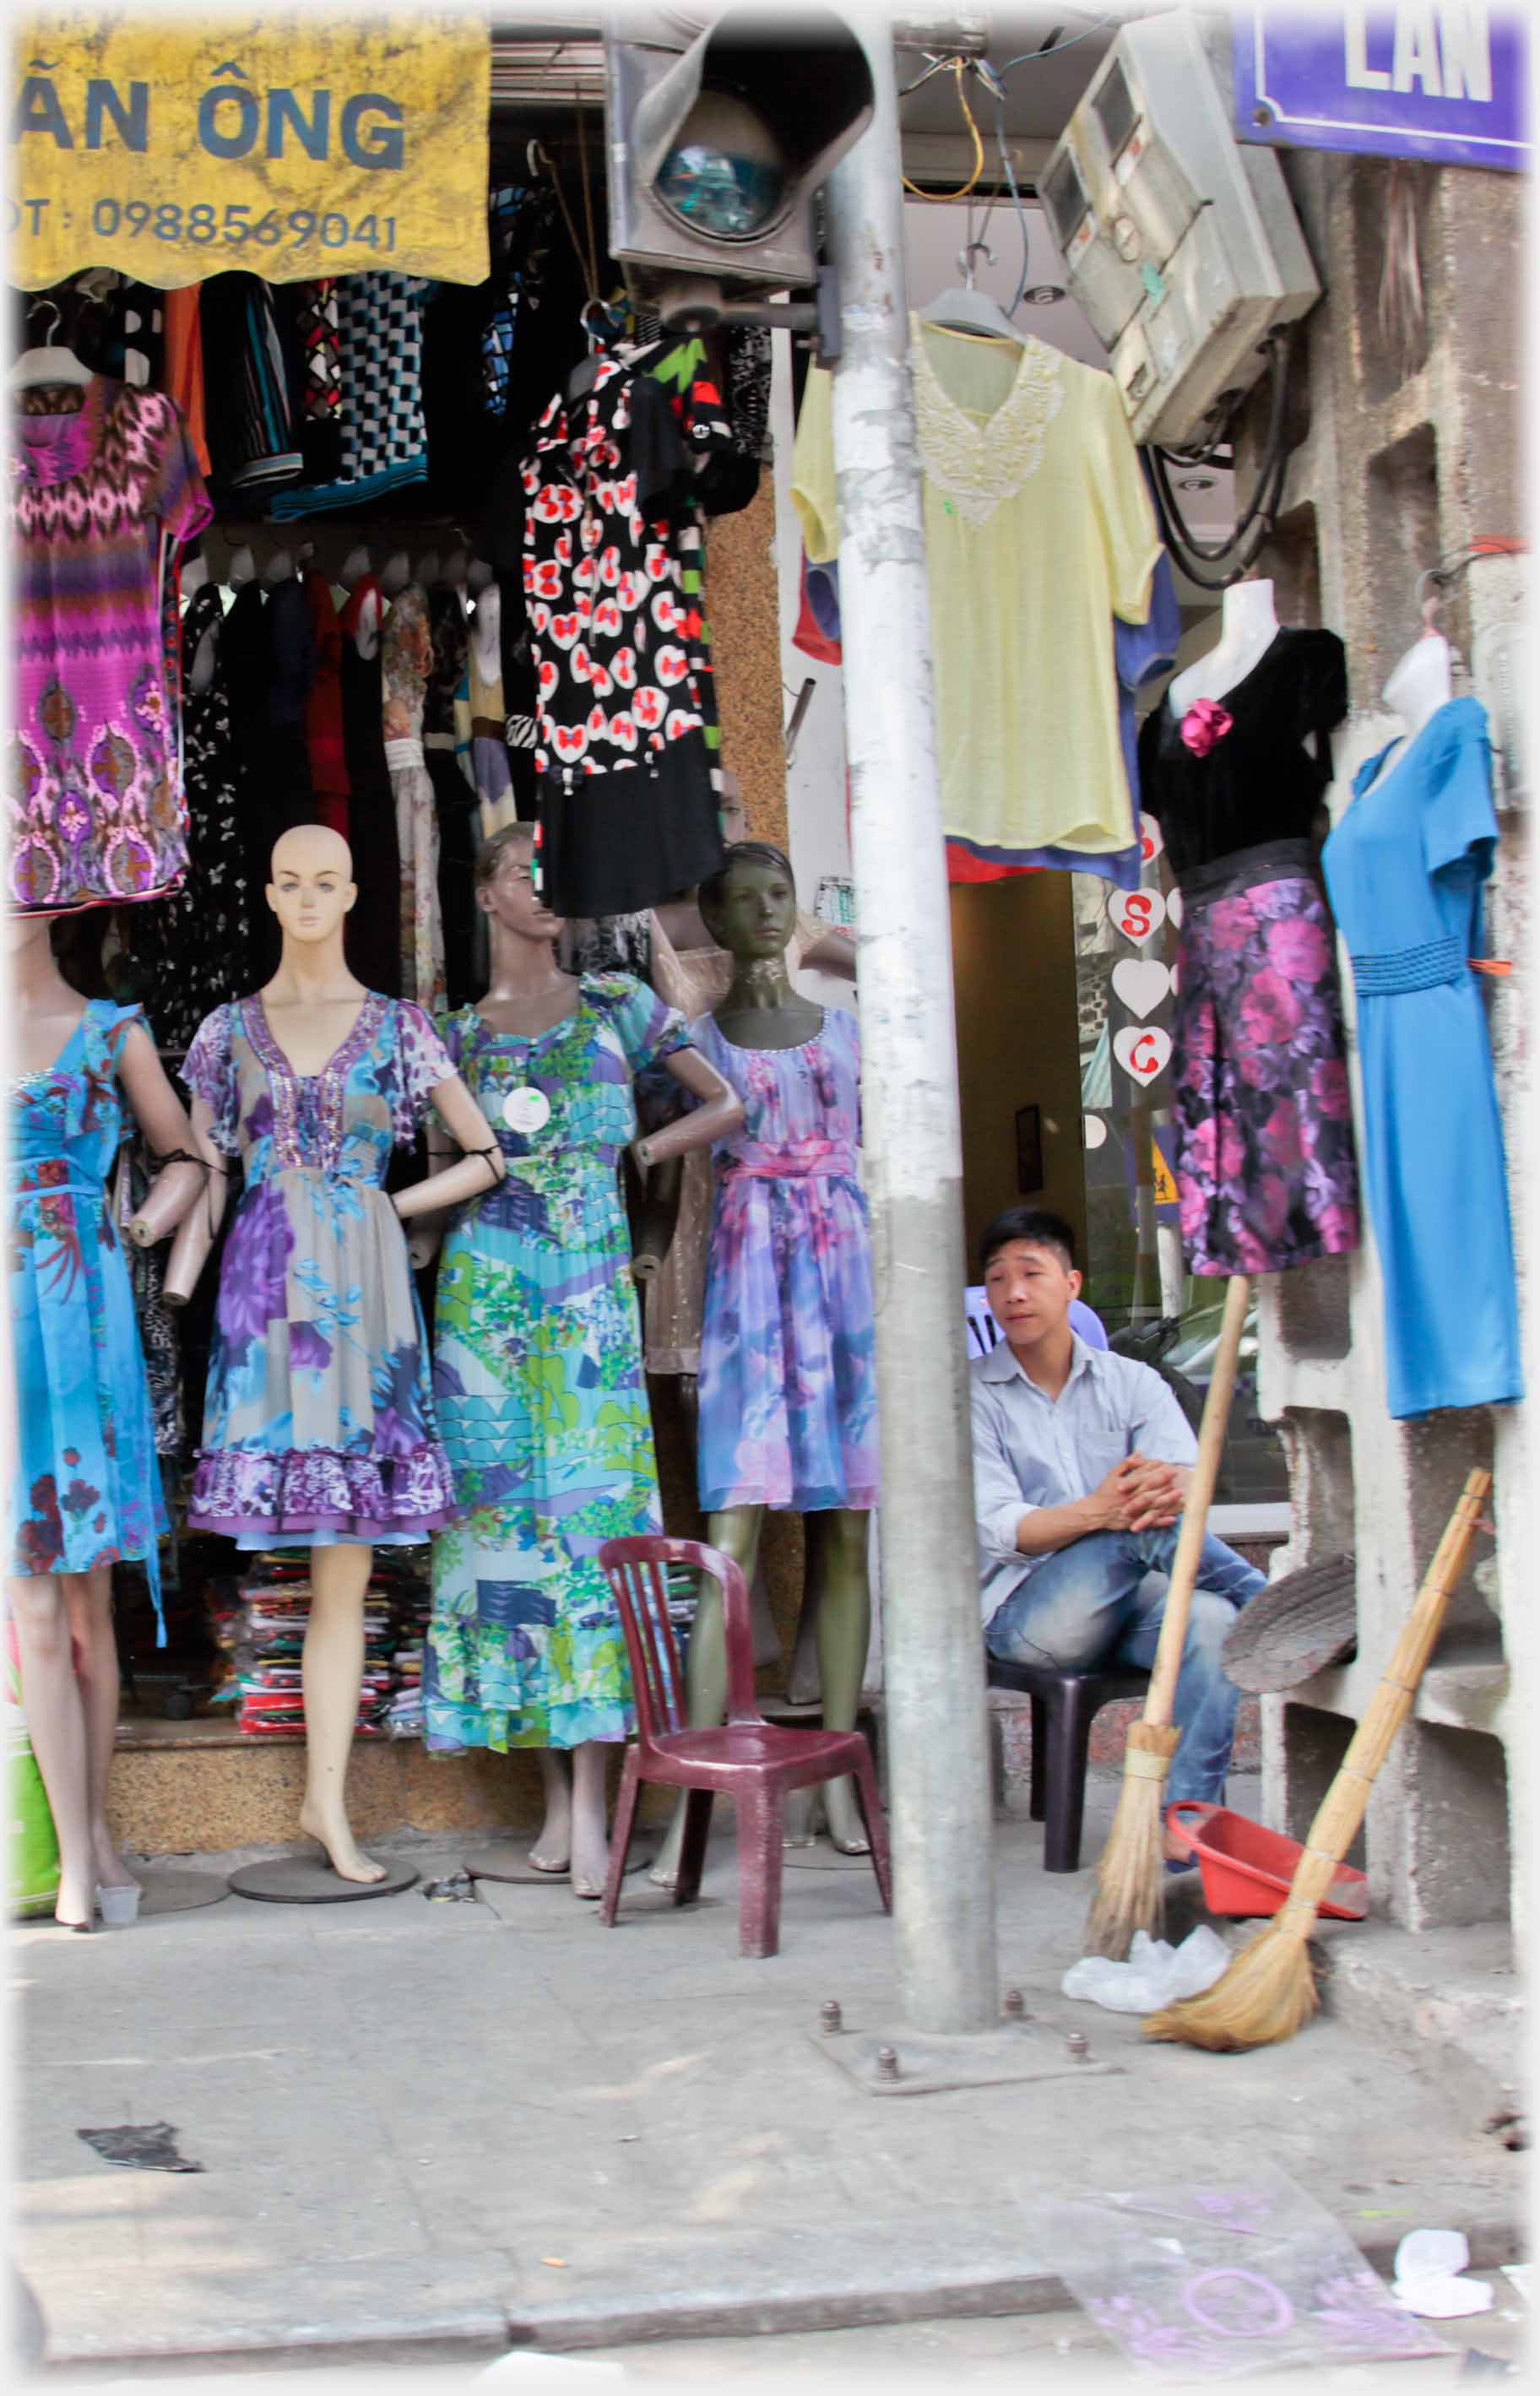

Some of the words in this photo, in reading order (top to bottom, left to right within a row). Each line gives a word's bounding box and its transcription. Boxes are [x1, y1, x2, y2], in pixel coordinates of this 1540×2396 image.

[198, 62, 405, 171] ÔNG
[93, 198, 396, 252] 0988569041
[1121, 894, 1152, 937] S
